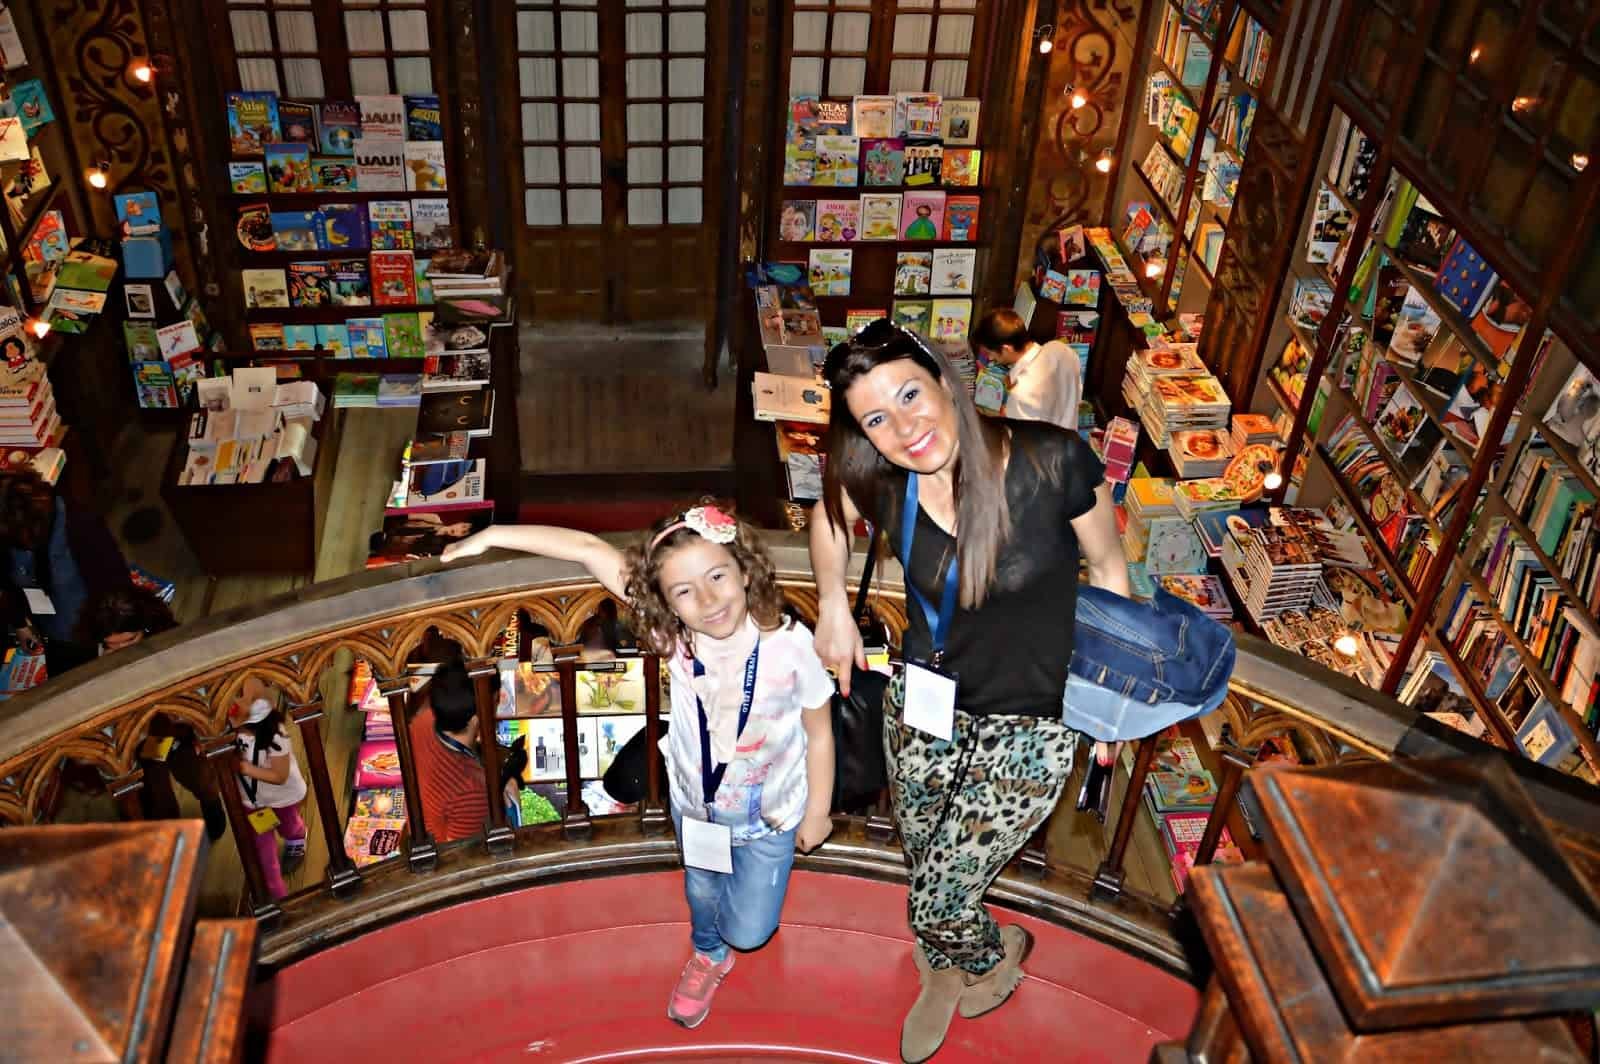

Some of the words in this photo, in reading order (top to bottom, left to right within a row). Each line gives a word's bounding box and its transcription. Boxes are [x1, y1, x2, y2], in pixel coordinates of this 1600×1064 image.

[324, 104, 357, 113] ATLAS
[817, 103, 848, 112] ATLAS
[357, 156, 400, 167] UAU!
